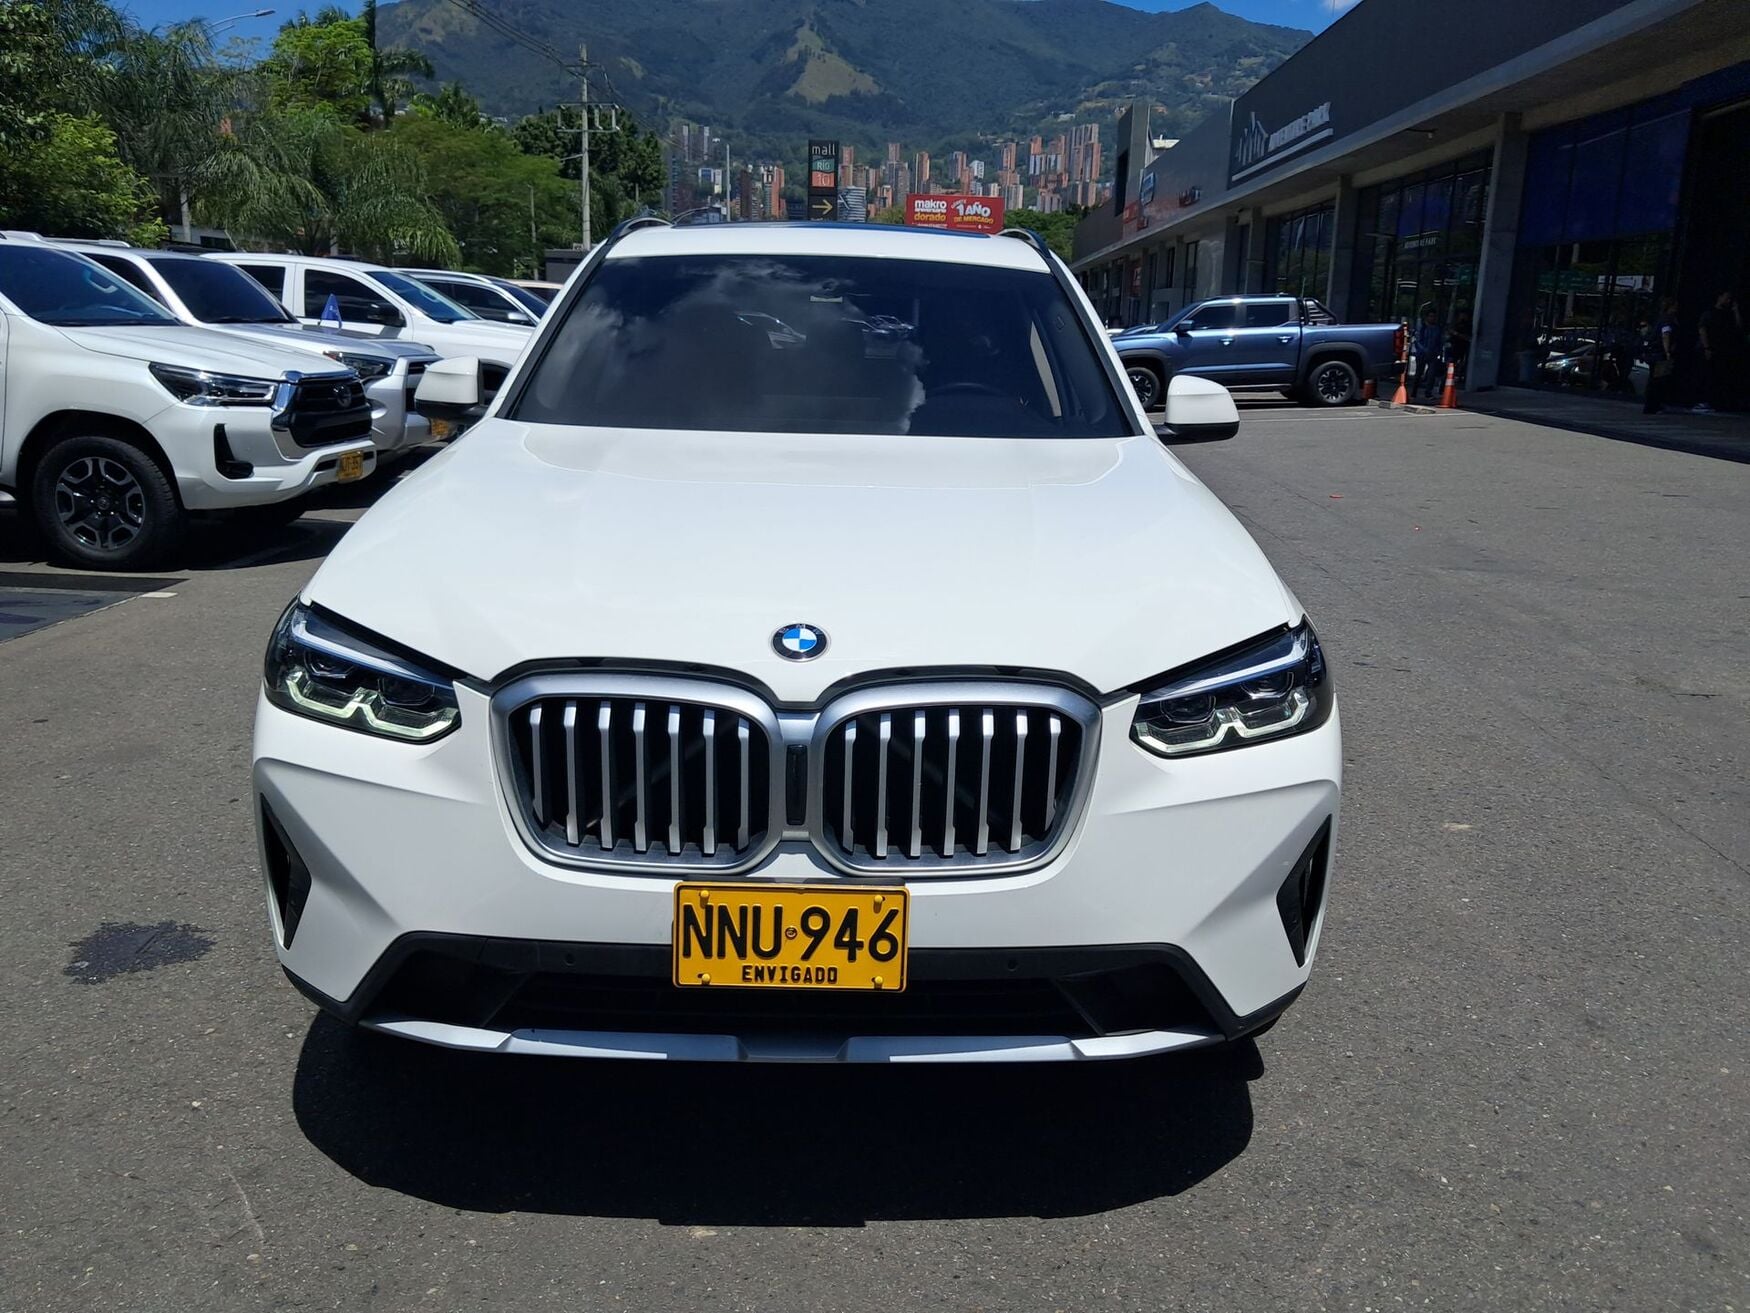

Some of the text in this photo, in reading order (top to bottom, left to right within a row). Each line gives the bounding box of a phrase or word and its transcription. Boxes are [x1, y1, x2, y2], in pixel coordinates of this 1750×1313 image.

[812, 143, 835, 155] mall
[914, 198, 947, 209] makro
[956, 203, 964, 216] 1
[965, 201, 991, 217] AÑO
[914, 212, 947, 222] dorado
[963, 215, 994, 224] MERCADO
[682, 904, 899, 962] NNU 946
[742, 964, 838, 984] ENVIGADO
